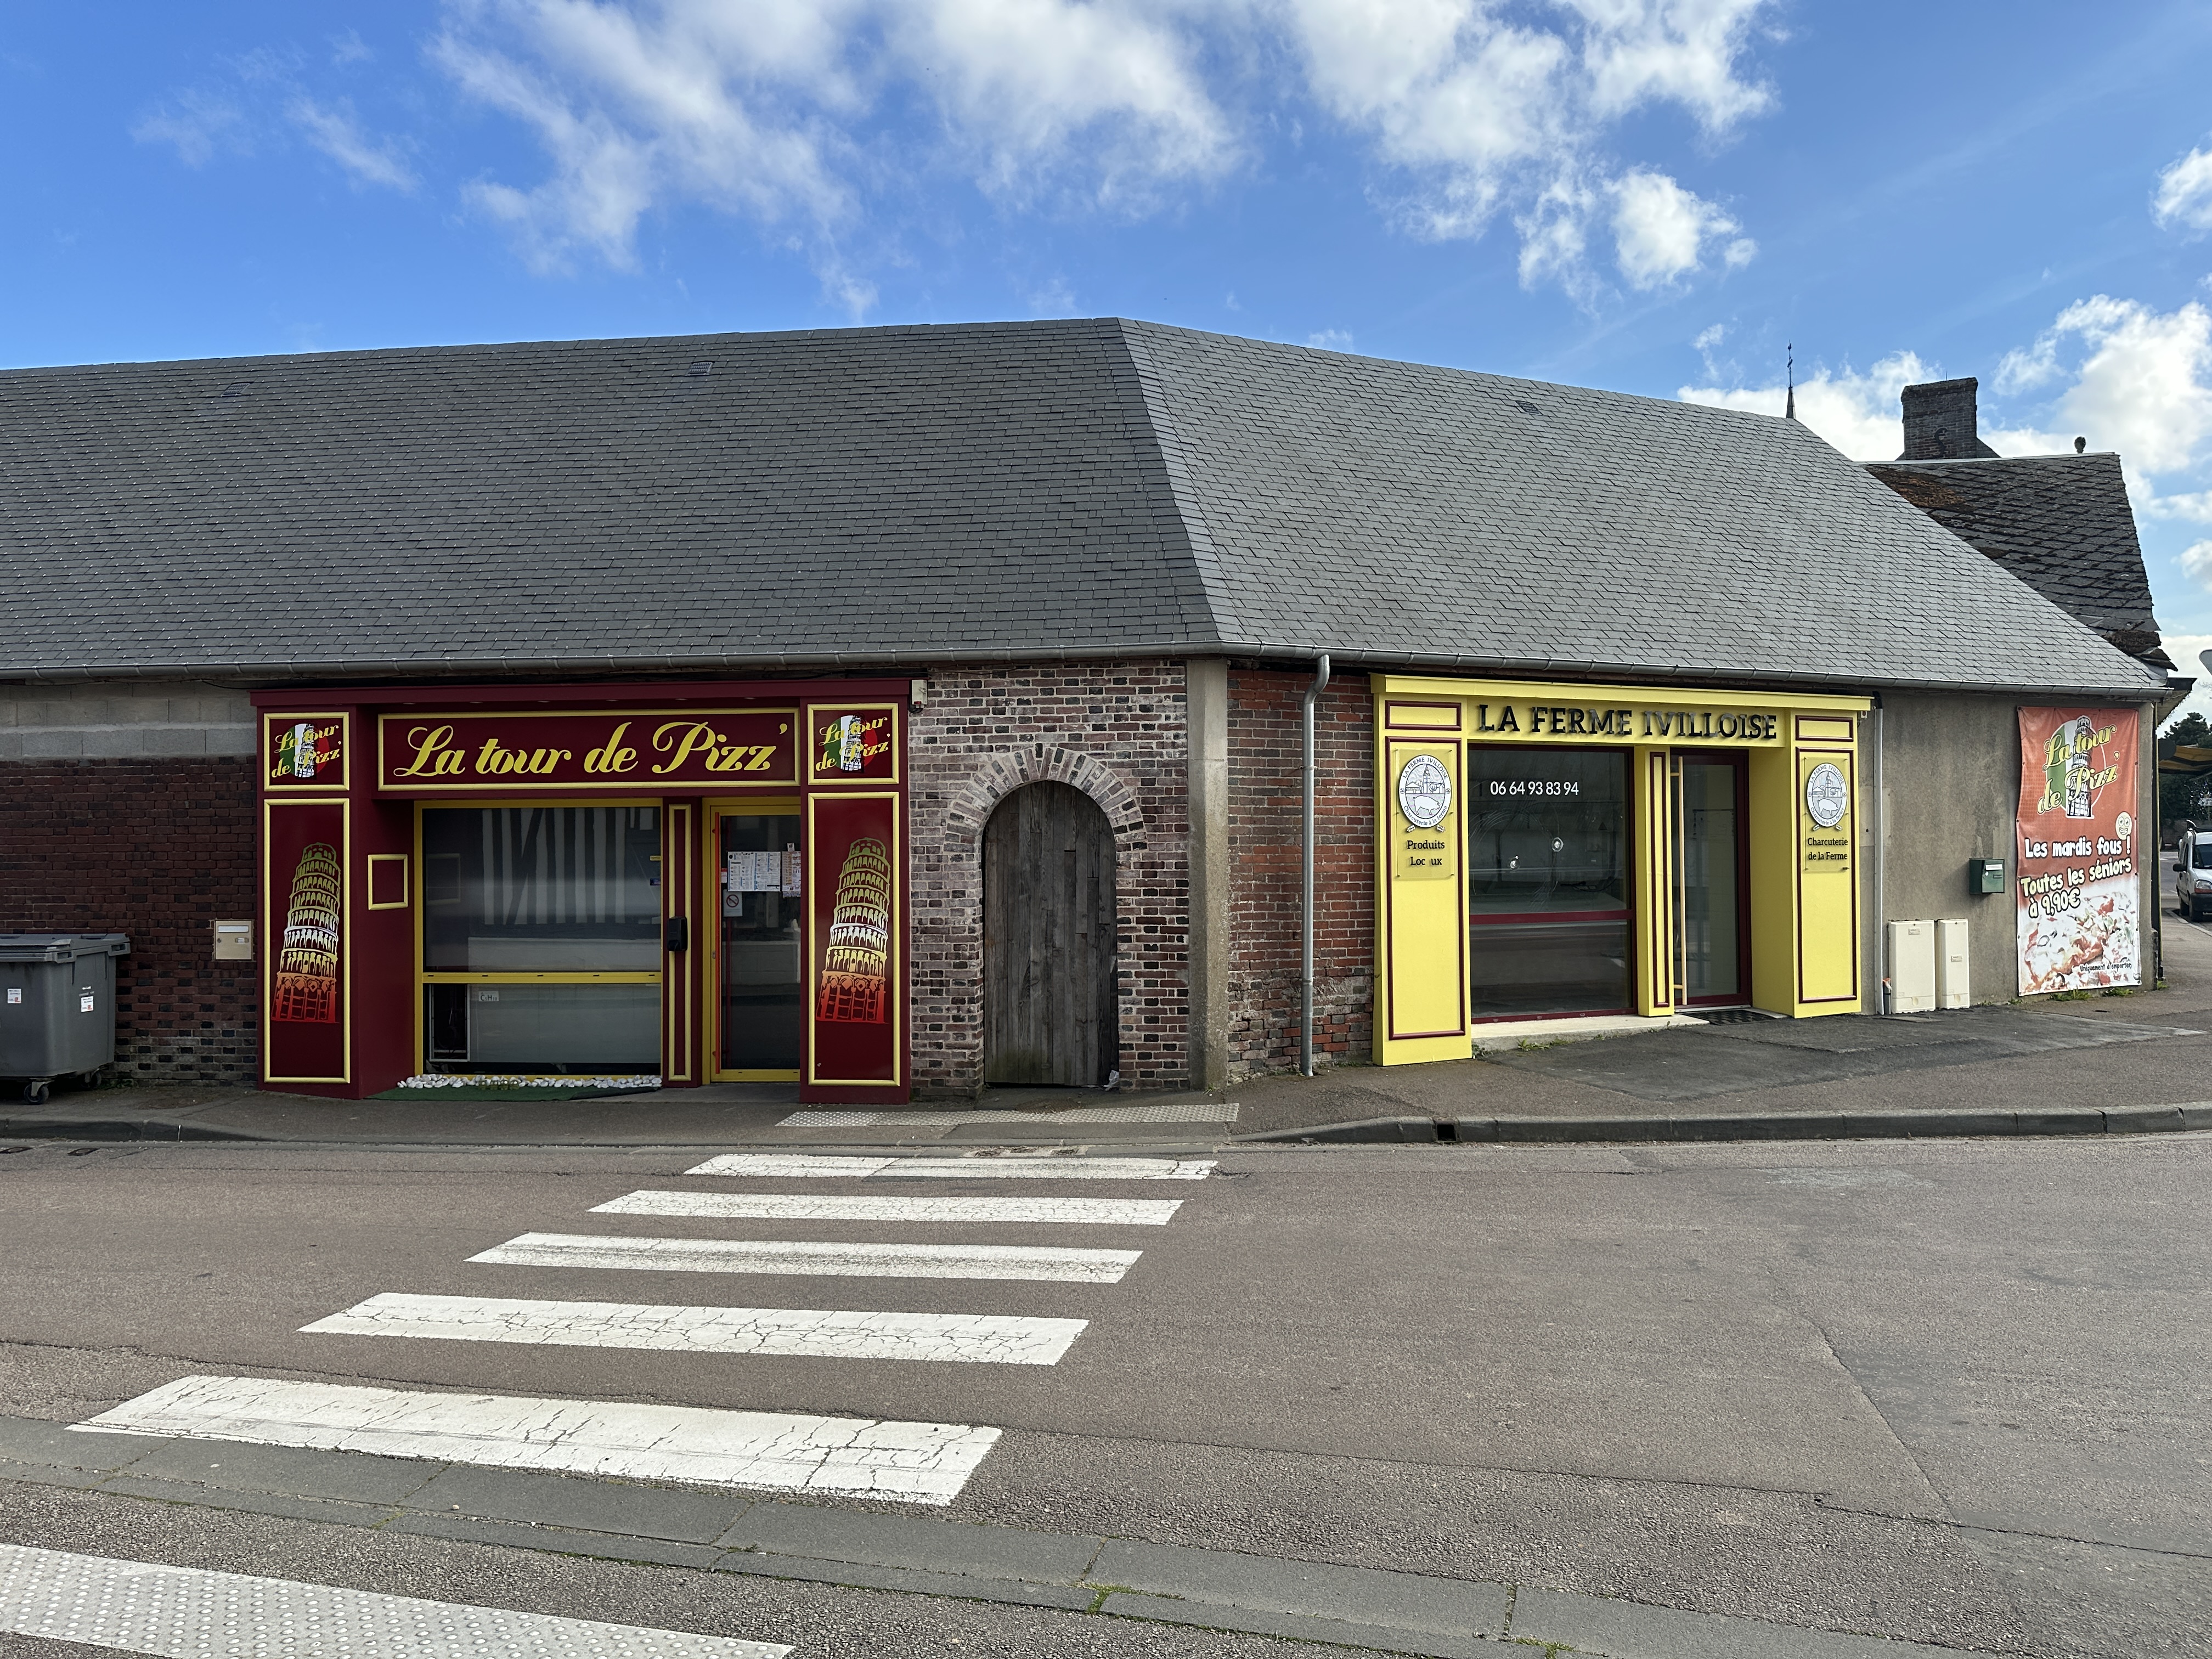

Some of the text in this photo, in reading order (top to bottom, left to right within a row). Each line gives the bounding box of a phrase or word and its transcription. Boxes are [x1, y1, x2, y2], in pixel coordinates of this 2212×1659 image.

[819, 717, 888, 746] La tour
[1479, 704, 1776, 738] LA FERME IVILLOISE
[274, 725, 339, 754] La tour
[393, 721, 787, 777] La tour de Pizz'
[2042, 724, 2117, 772] La tour
[272, 758, 291, 778] de
[816, 751, 837, 771] de
[1403, 757, 1448, 780] LA FERME IVILLOISE
[1490, 781, 1579, 795] 06 64 93 83 94
[2037, 778, 2063, 814] de
[1404, 805, 1428, 826] Charcuterie
[1437, 805, 1447, 820] ferme
[1407, 839, 1445, 849] Produits
[1808, 837, 1848, 845] Charcuterie
[2024, 834, 2131, 859] Les mardis fous !
[1808, 851, 1848, 860] de la Ferme
[2020, 857, 2132, 896] Toutes les séniors
[2029, 887, 2081, 918] à 9,90€
[2080, 964, 2105, 973] Uniquement
